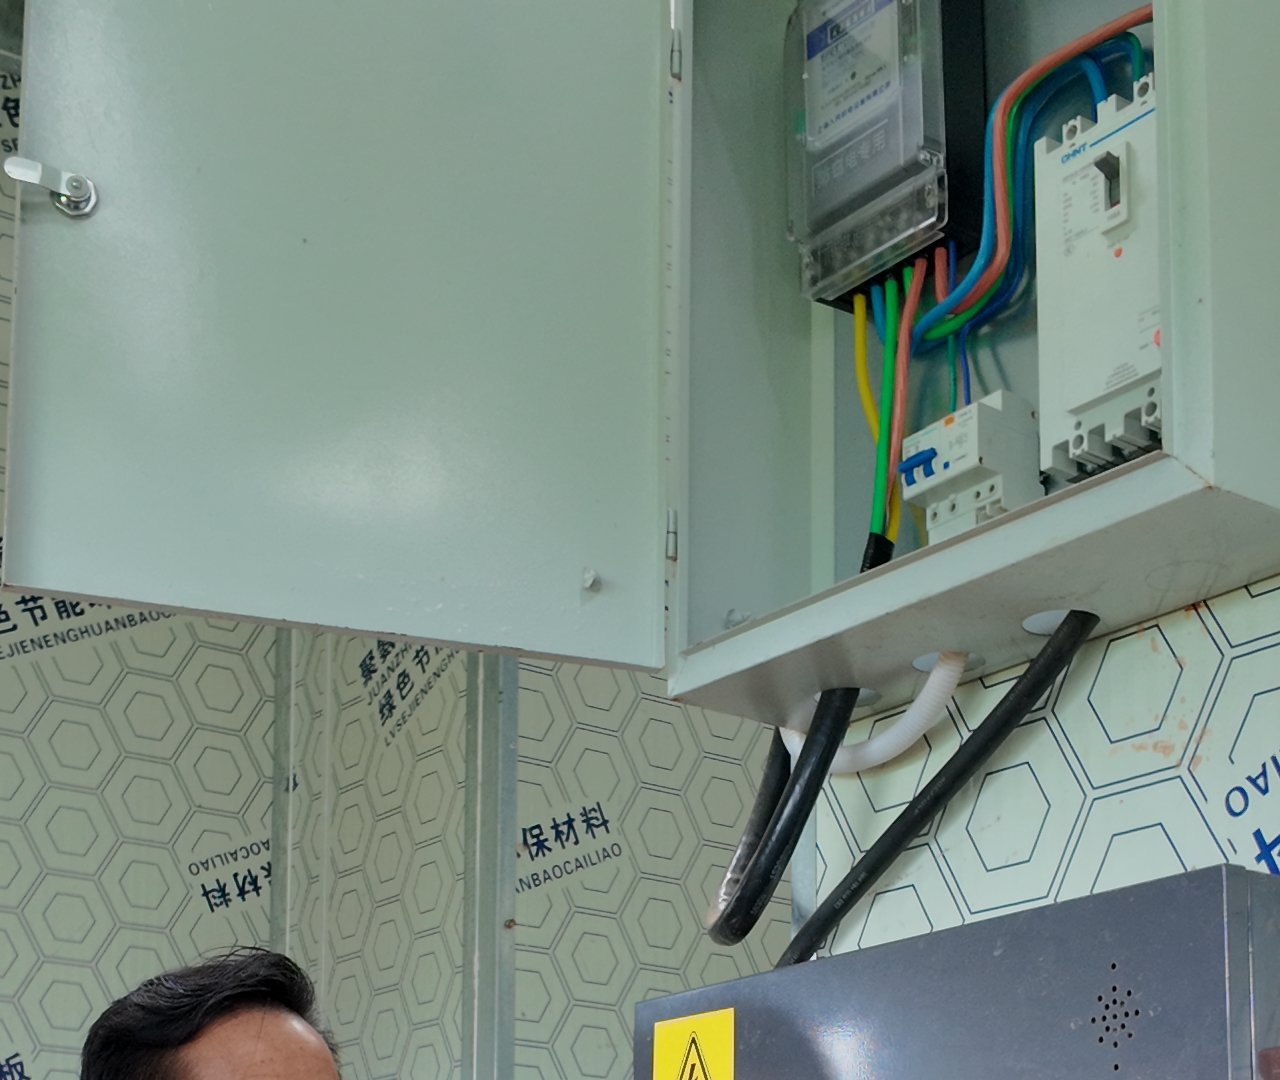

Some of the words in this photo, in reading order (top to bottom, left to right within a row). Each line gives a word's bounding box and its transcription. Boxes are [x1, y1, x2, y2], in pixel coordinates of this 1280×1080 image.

[378, 645, 443, 727] 绿色节
[516, 801, 610, 862] 保材料
